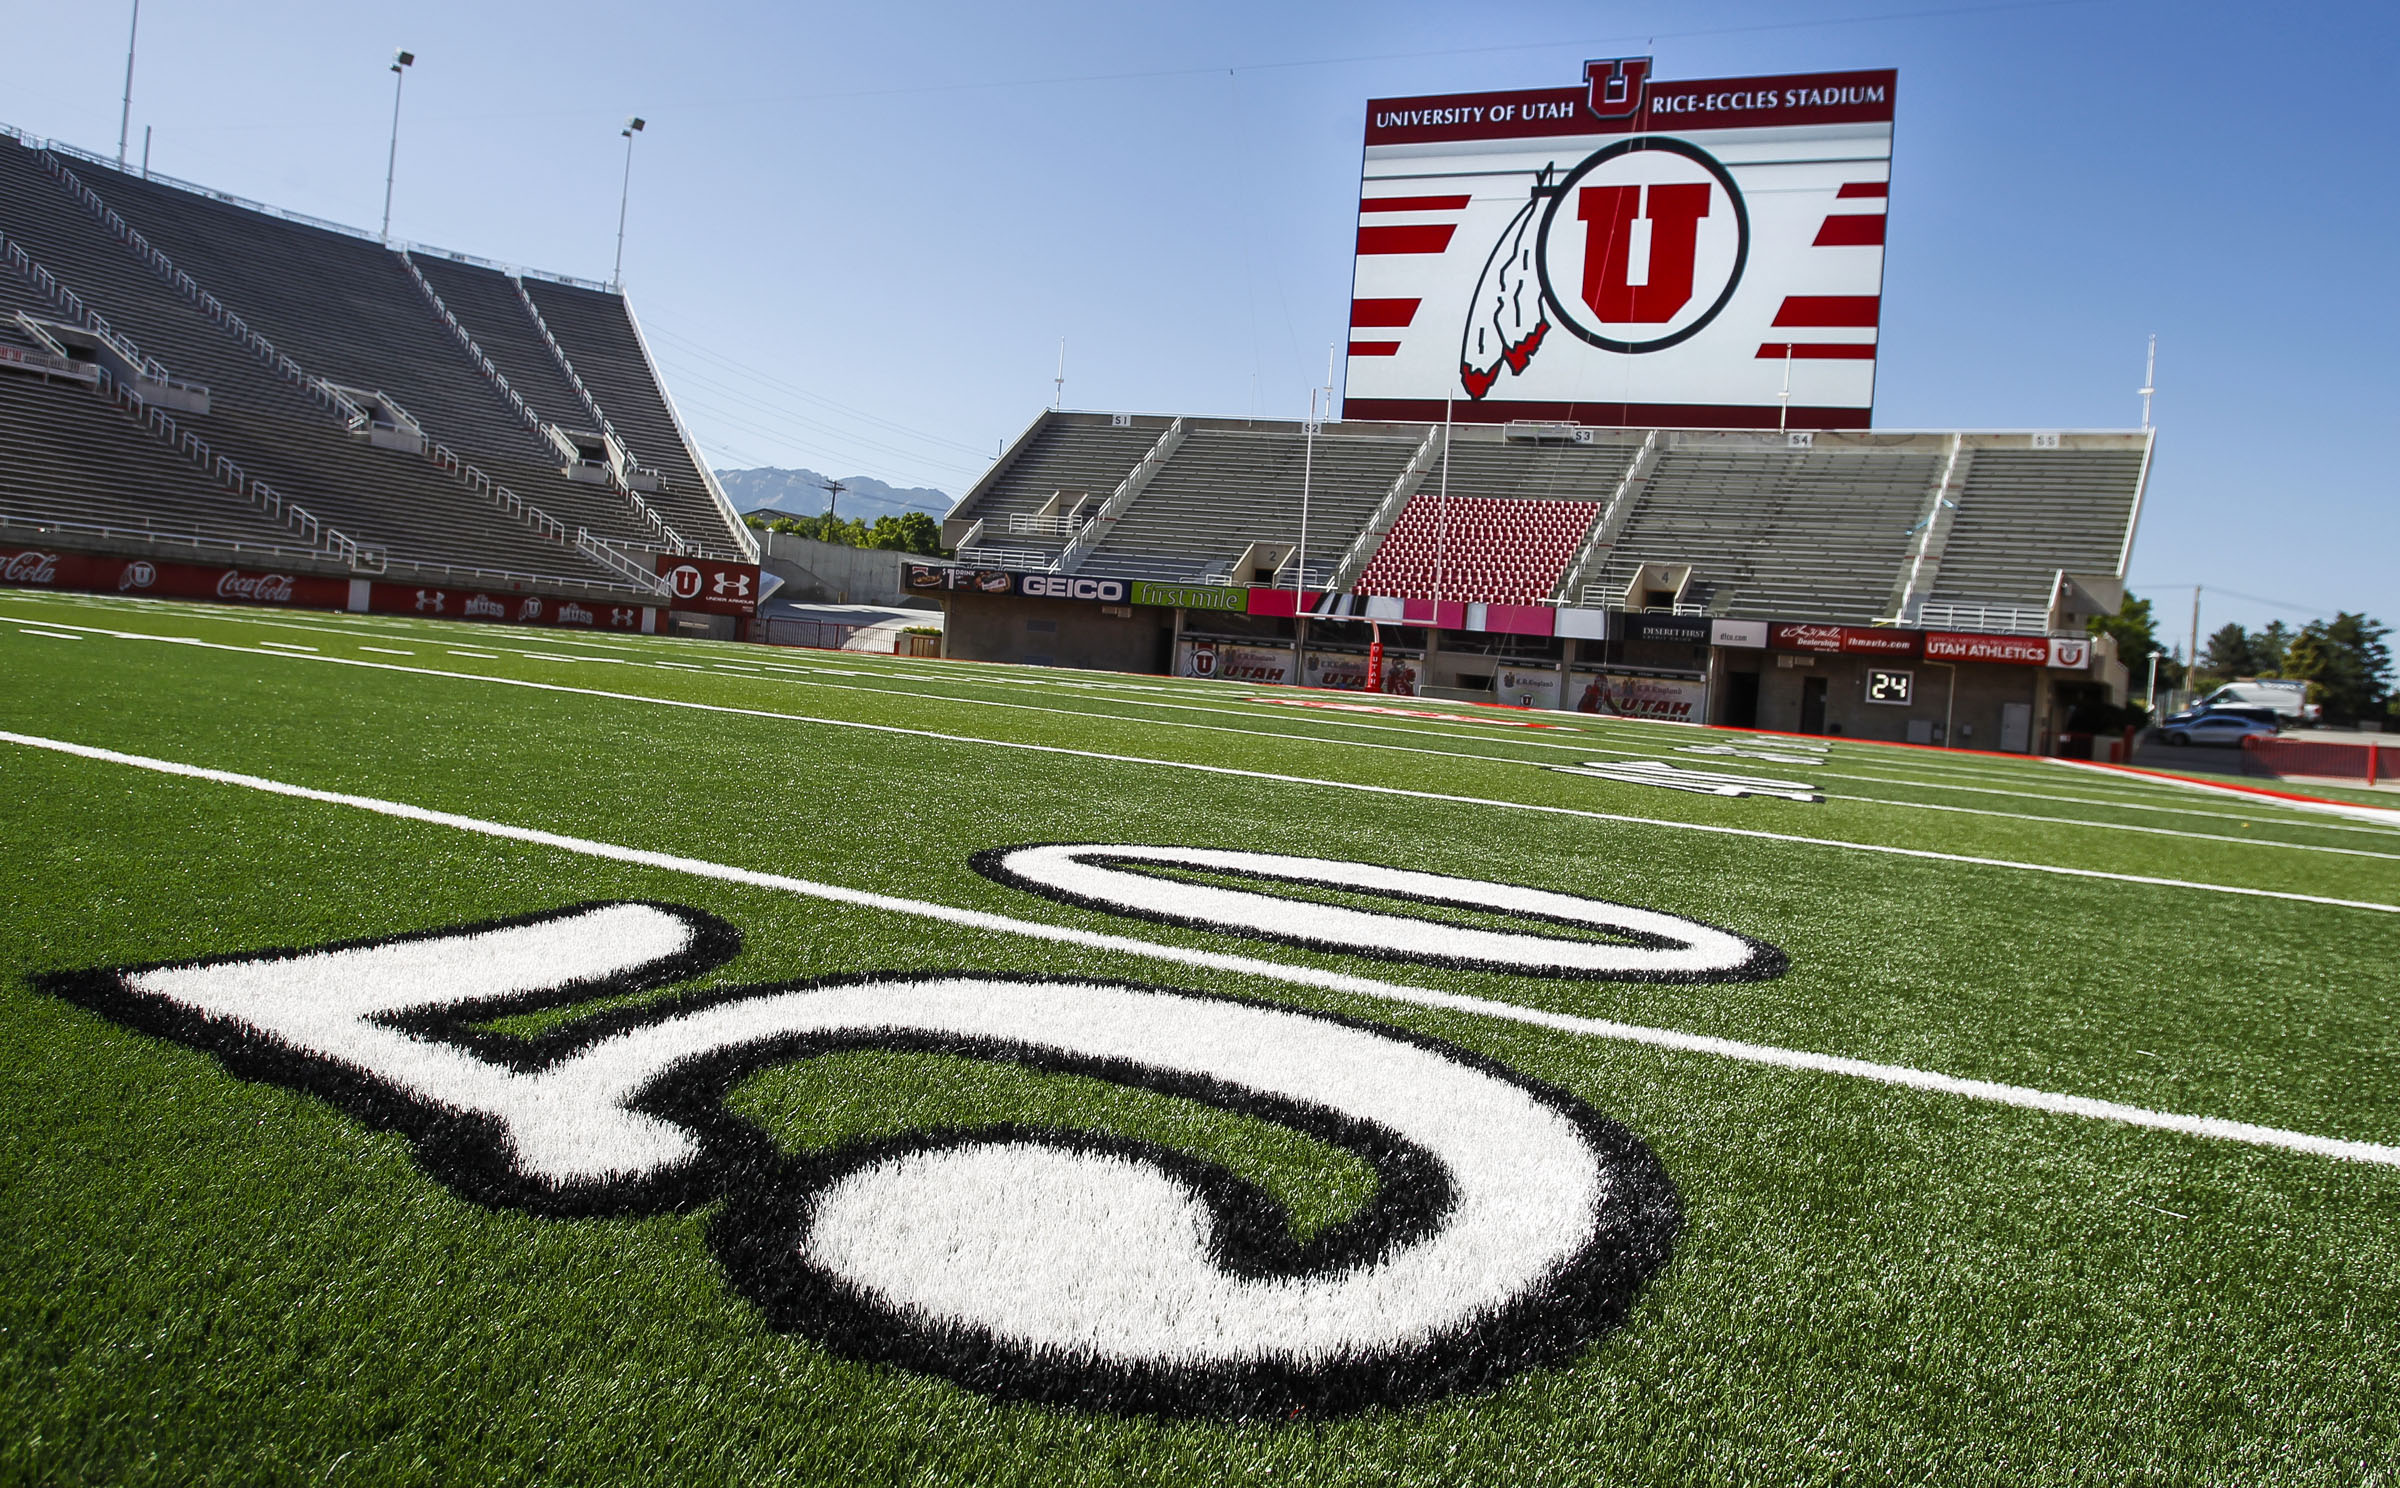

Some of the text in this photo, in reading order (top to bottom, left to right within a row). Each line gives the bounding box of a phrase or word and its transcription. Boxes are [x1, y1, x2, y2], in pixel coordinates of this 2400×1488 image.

[1652, 85, 1886, 114] RICE-ECCLES STADIUM
[1376, 101, 1575, 128] UNIVERSITY OF UTAH
[1577, 183, 1711, 324] U
[1269, 551, 1277, 562] 2
[217, 570, 296, 601] Coca-Cola
[676, 571, 699, 595] U
[1022, 576, 1123, 601] GEICO
[1141, 583, 1239, 610] first mile
[1681, 629, 1705, 638] FIRST
[1797, 637, 1840, 648] Dealerships
[1927, 641, 2046, 661] UTAH ATHLETICS
[1196, 655, 1214, 674] U
[1223, 665, 1286, 680] UTAH
[1872, 673, 1907, 698] 24
[1621, 698, 1693, 716] UTAH
